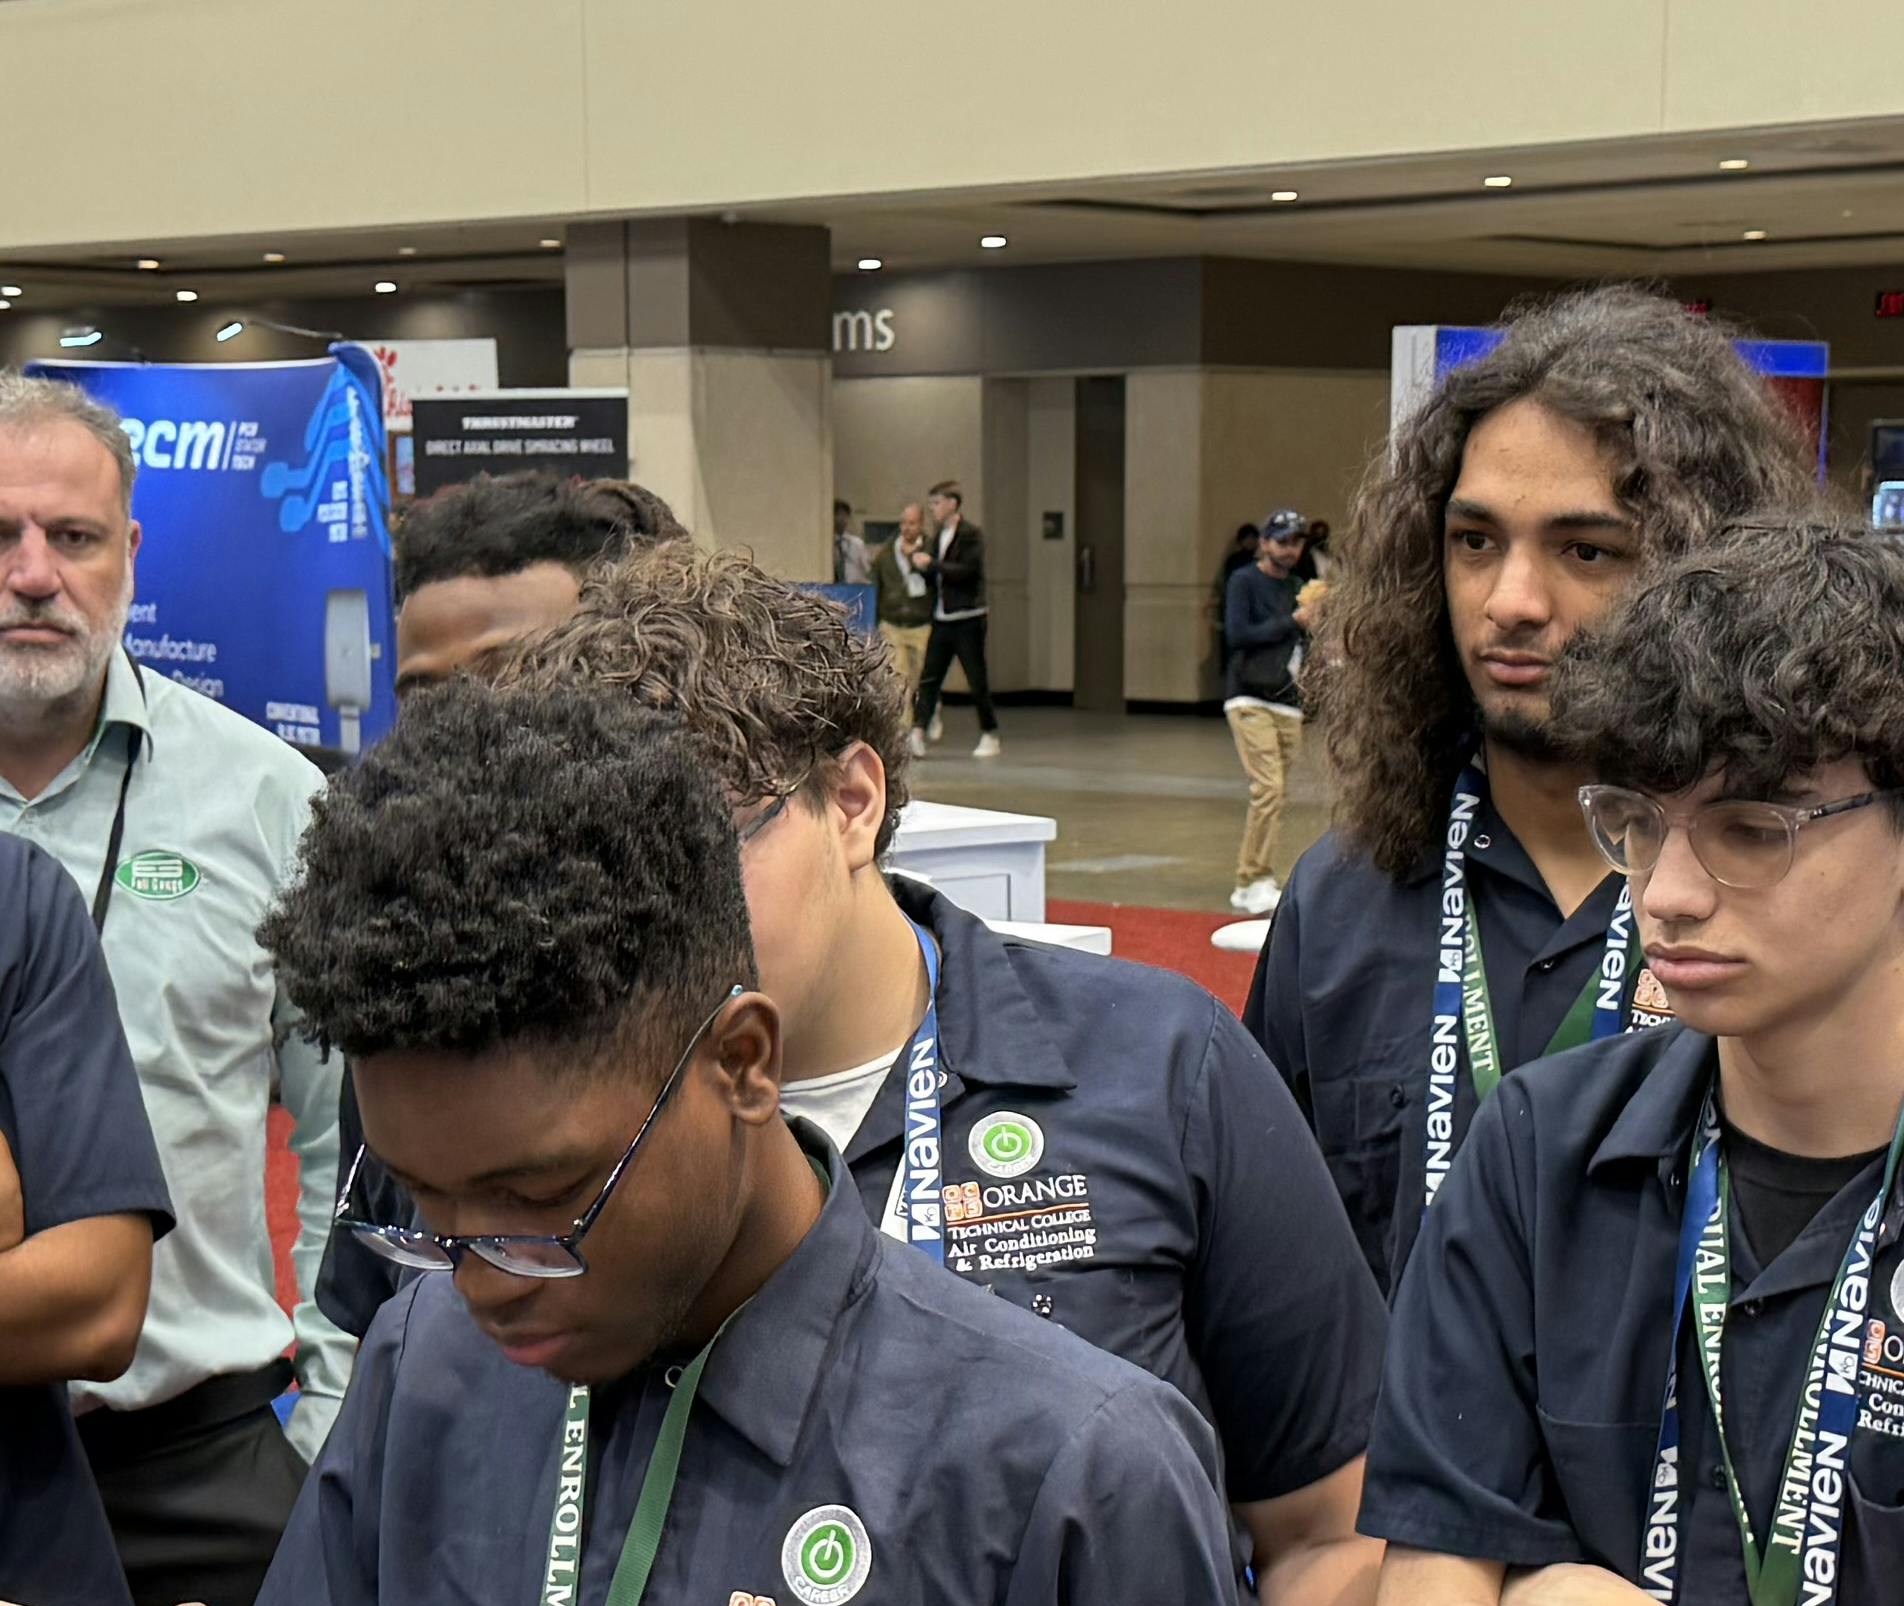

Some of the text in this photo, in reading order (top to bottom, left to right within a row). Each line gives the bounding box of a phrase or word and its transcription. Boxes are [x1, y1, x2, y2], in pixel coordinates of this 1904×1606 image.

[982, 1174, 1088, 1208] ORANGE
[948, 1210, 1092, 1240] TECHNICAL COLLEGE
[948, 1227, 1097, 1258] Air Conditioning
[955, 1245, 1095, 1272] & Refrigeration
